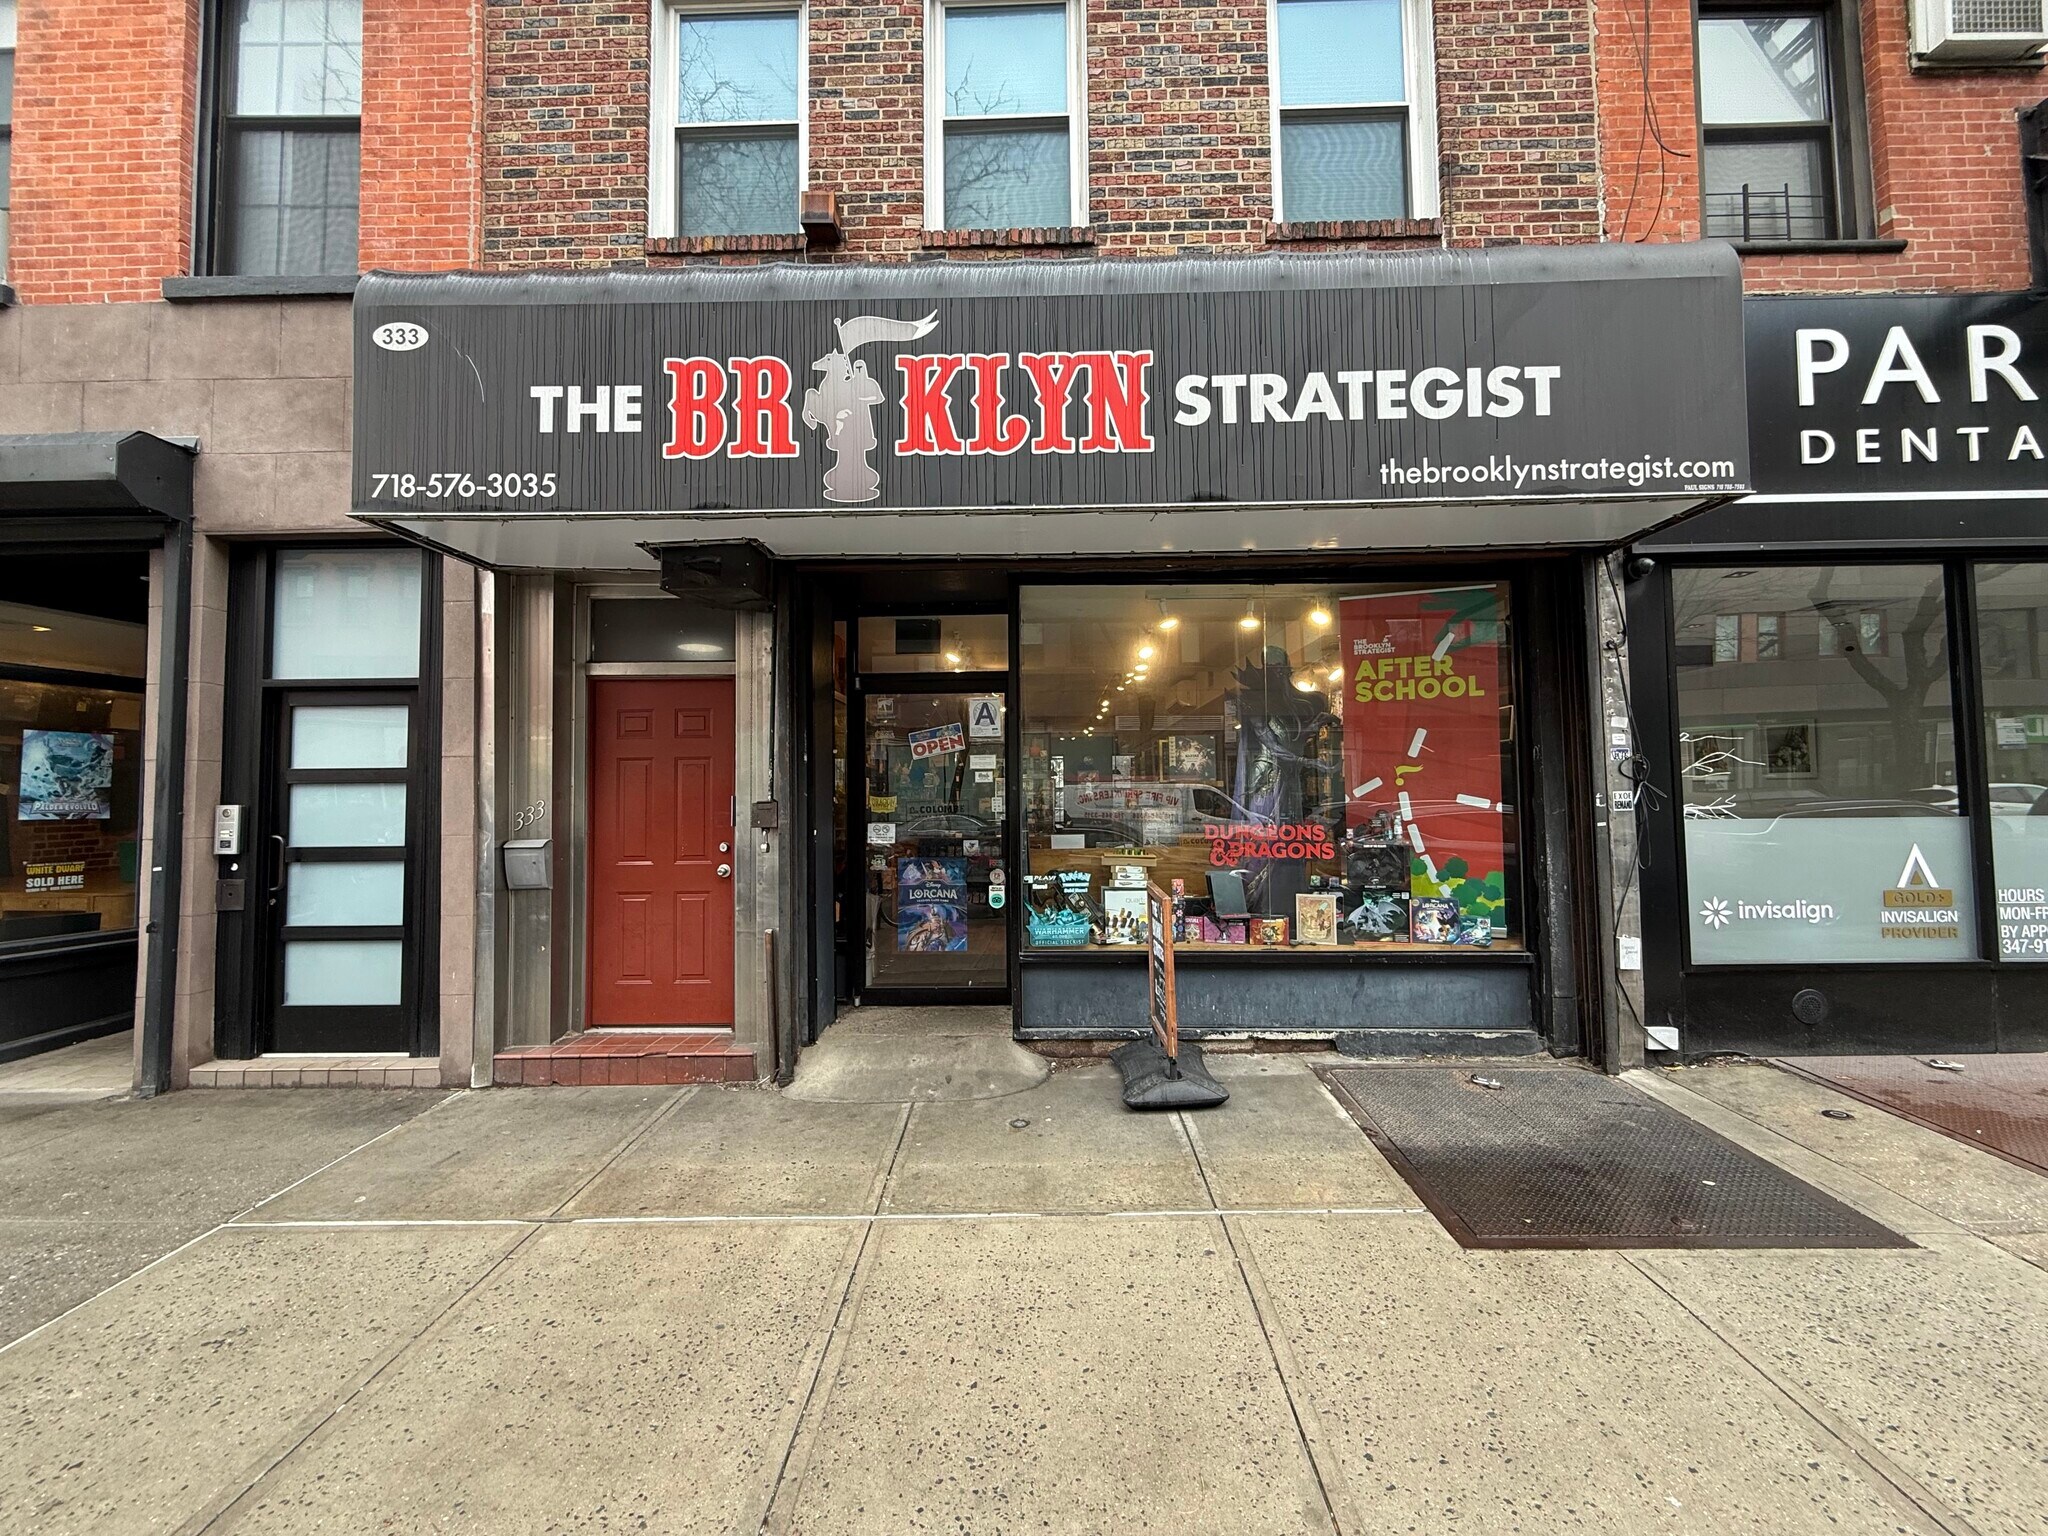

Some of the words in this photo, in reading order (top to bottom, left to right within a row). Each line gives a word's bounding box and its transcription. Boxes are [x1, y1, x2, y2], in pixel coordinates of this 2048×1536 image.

[382, 328, 419, 345] 333
[1795, 325, 2040, 407] PAR
[530, 385, 642, 433] THE
[1172, 365, 1562, 426] STRATEGIST
[1800, 425, 2046, 465] DENTA
[1380, 454, 1736, 490] thebrooklynstrategist.com
[371, 472, 557, 499] 718-576-3035
[1353, 647, 1396, 656] STRATEGIST
[1354, 655, 1455, 681] AFTER
[1355, 675, 1485, 703] SCHOOL
[974, 702, 996, 726] A
[912, 735, 964, 757] OPEN
[514, 800, 545, 831] 333
[1202, 824, 1326, 841] DUNGEONS
[1209, 838, 1238, 867] &
[1229, 842, 1335, 860] DRAGONS
[26, 866, 53, 875] WHITE
[55, 864, 85, 873] DWARF
[26, 876, 54, 888] SOLD
[57, 874, 84, 885] HERE
[909, 889, 958, 900] LORCANA
[1998, 888, 2045, 902] HOURS
[1738, 899, 1834, 924] invisalign
[1881, 910, 1959, 923] INVISALIGN
[1034, 927, 1085, 935] WARHAMMER
[1881, 926, 1959, 939] PROVIDER
[2000, 924, 2019, 938] BY
